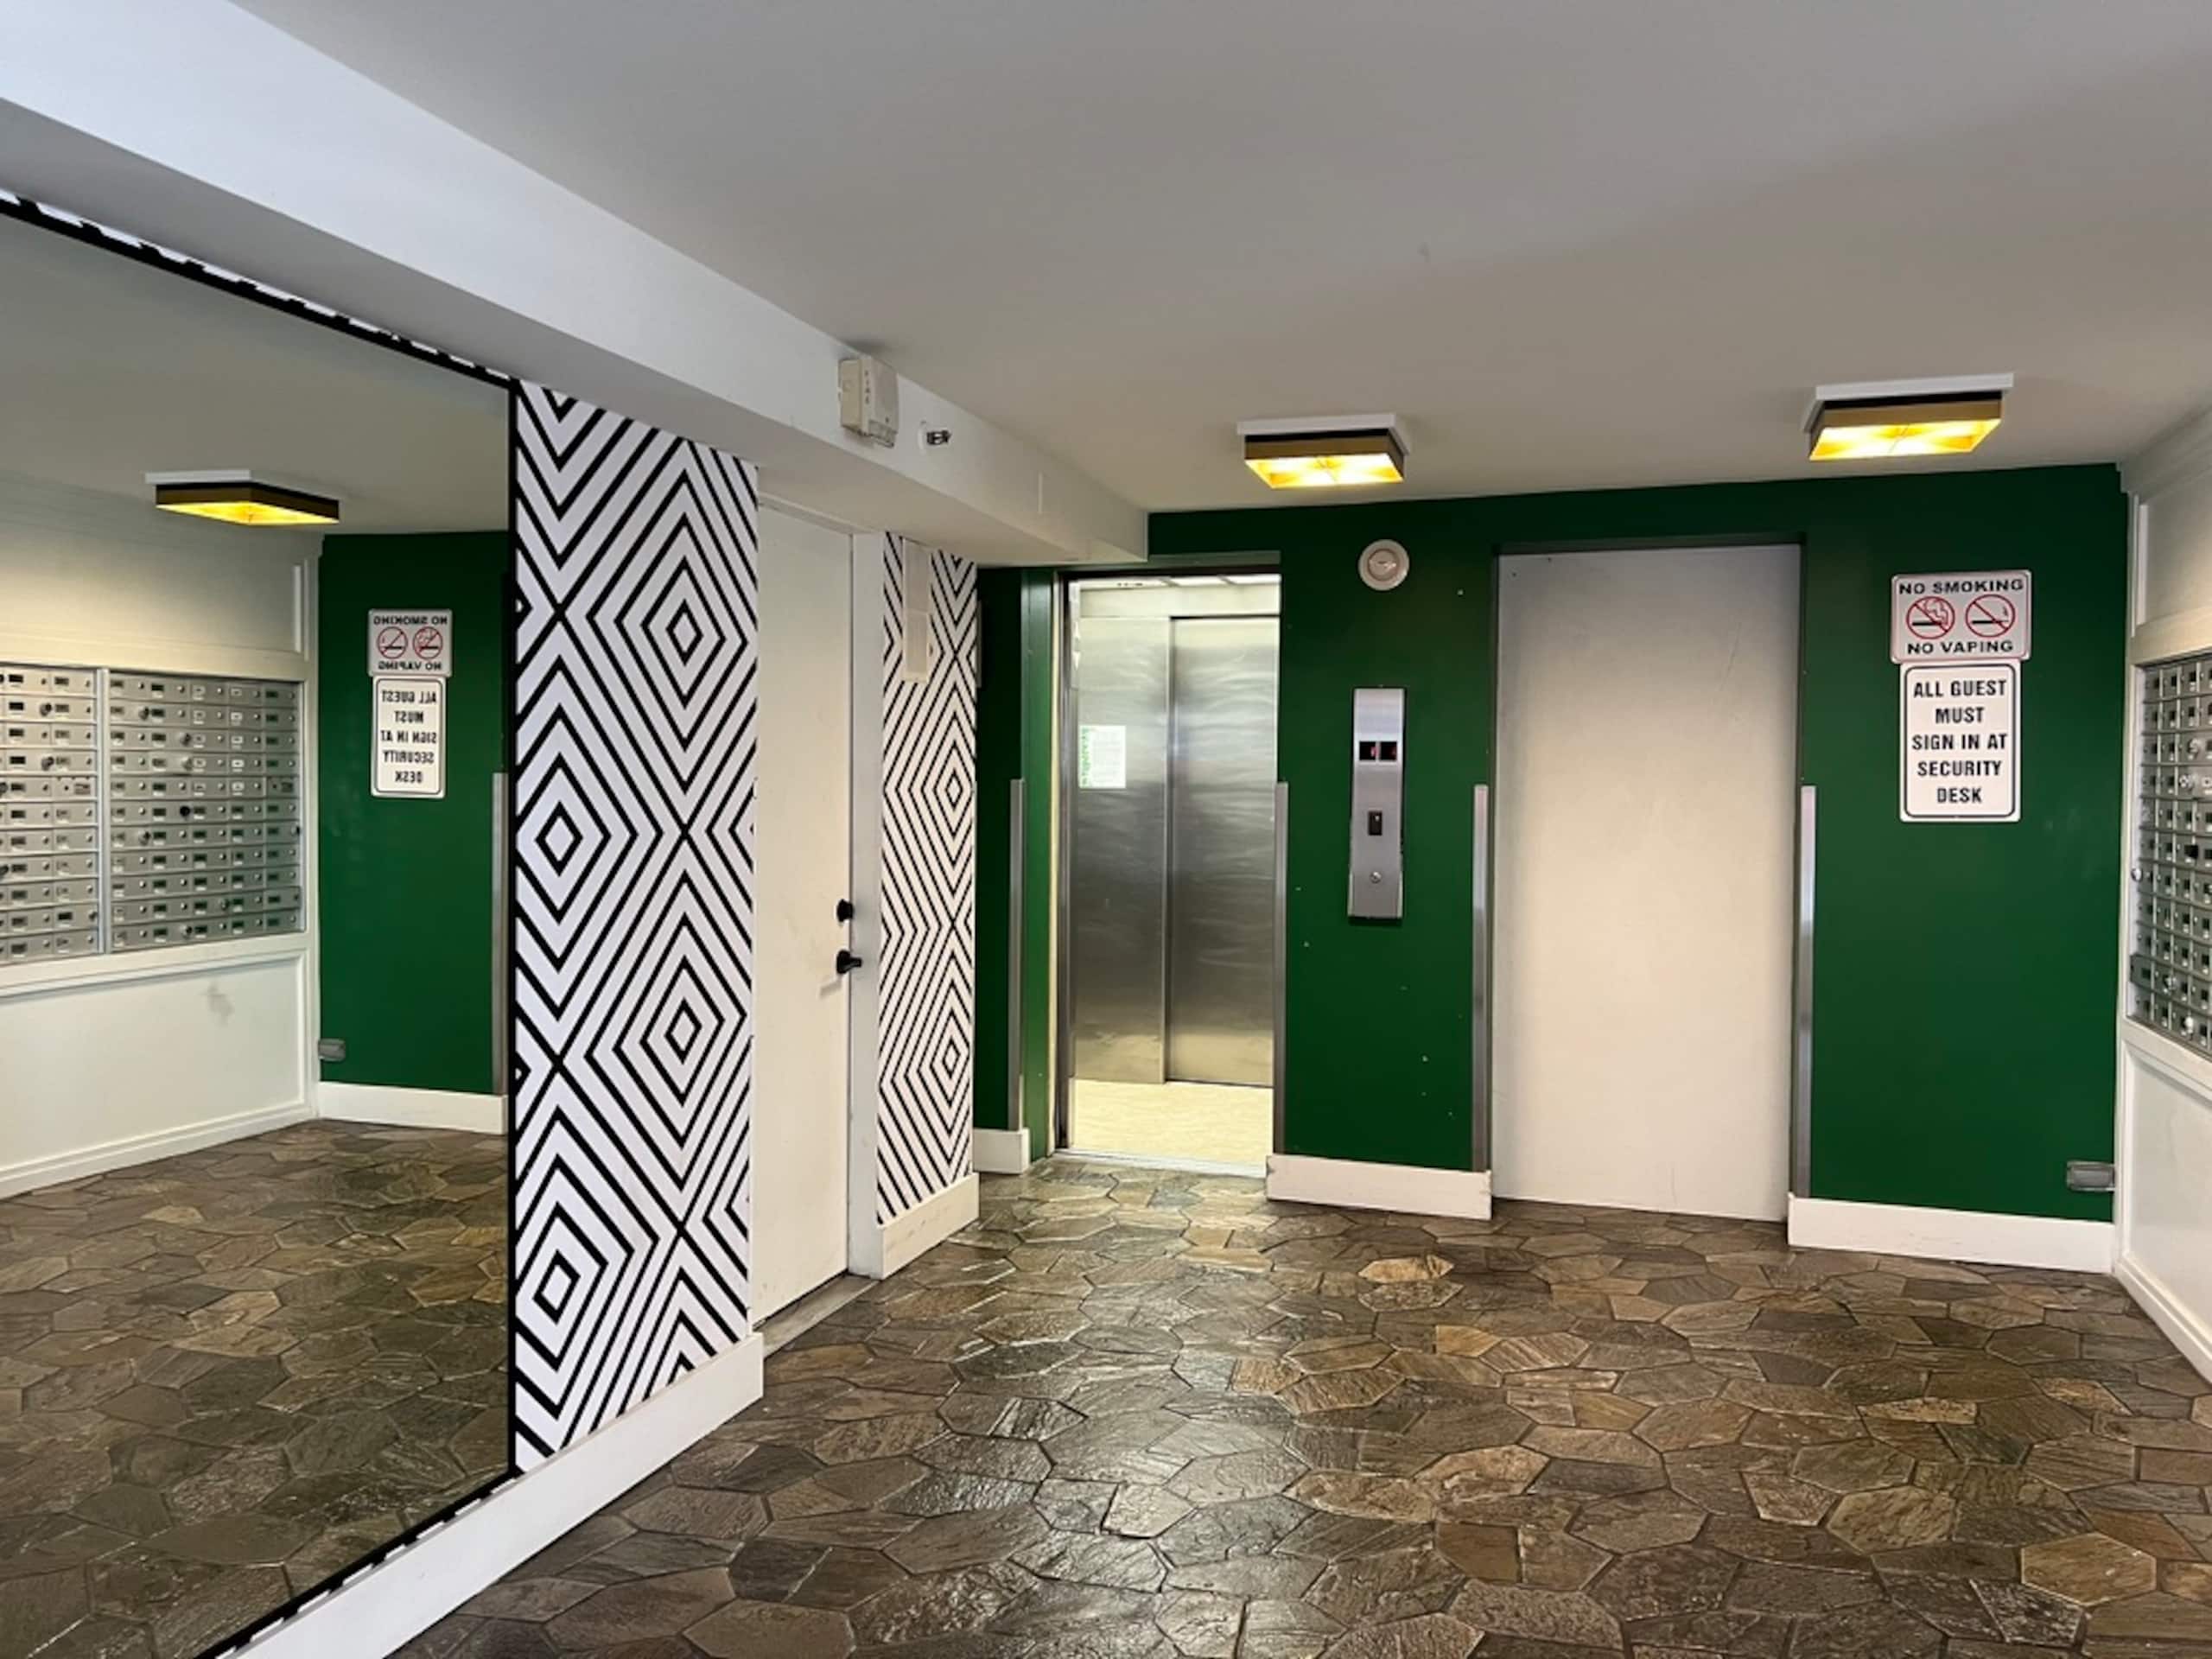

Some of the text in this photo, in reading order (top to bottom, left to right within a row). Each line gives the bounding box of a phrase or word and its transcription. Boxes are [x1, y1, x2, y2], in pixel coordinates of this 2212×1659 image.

[1899, 579, 2024, 594] NO SMOKING
[1908, 640, 2013, 654] NO VAPING
[1914, 680, 2006, 697] ALL GUEST
[1936, 708, 1985, 723] MUST
[1912, 734, 2007, 750] SIGN IN AT
[1917, 760, 2002, 776] SECURITY
[1937, 788, 1982, 803] DESK
